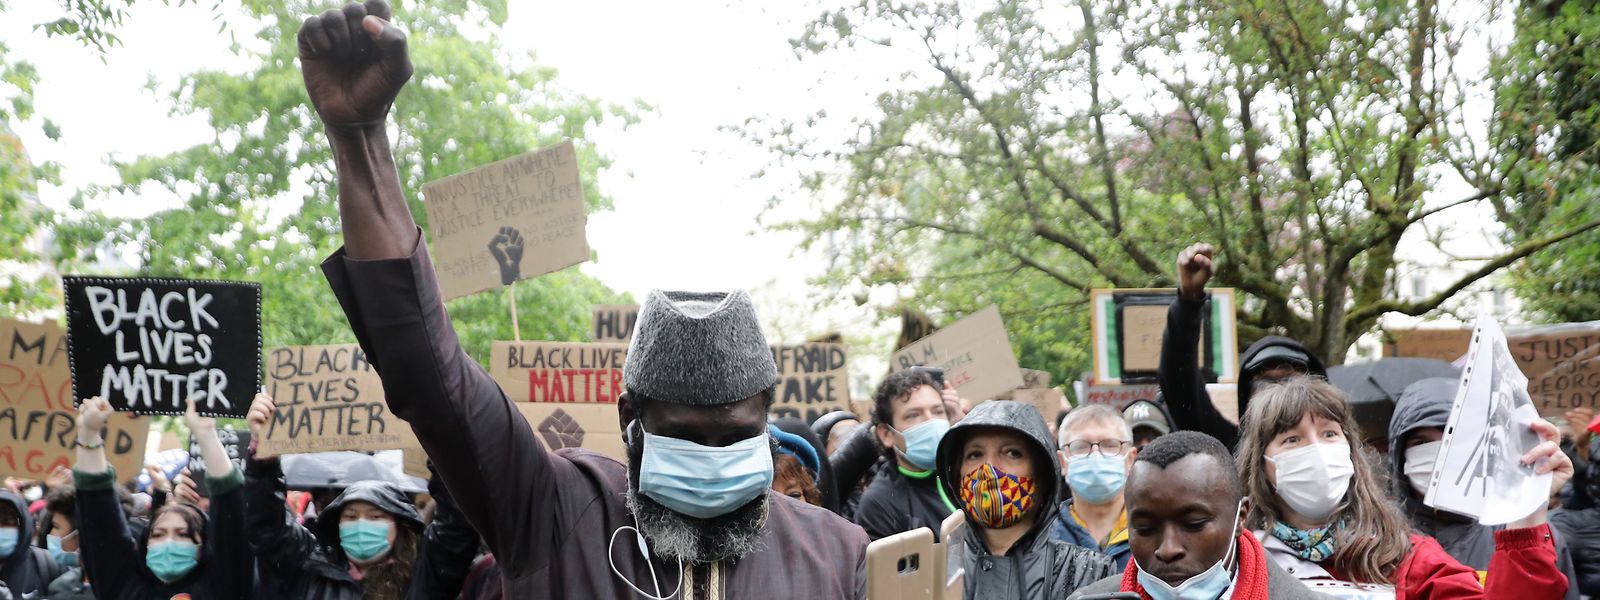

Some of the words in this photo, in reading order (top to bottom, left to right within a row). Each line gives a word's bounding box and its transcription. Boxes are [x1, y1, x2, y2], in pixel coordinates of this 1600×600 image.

[427, 168, 494, 204] INJUSTICE
[472, 177, 521, 210] THREAT
[535, 169, 556, 190] TO
[436, 208, 486, 238] JUSTICE
[85, 286, 220, 335] BLACK
[9, 328, 68, 366] MA
[115, 327, 213, 366] LIVES
[270, 348, 371, 380] BLACK
[508, 345, 573, 369] BLACK
[580, 347, 628, 368] LIVE
[101, 363, 231, 409] MATTER
[271, 377, 360, 407] LIVES
[528, 368, 624, 403] MATTER
[0, 407, 133, 454] AFRID
[266, 401, 386, 440] MATTER
